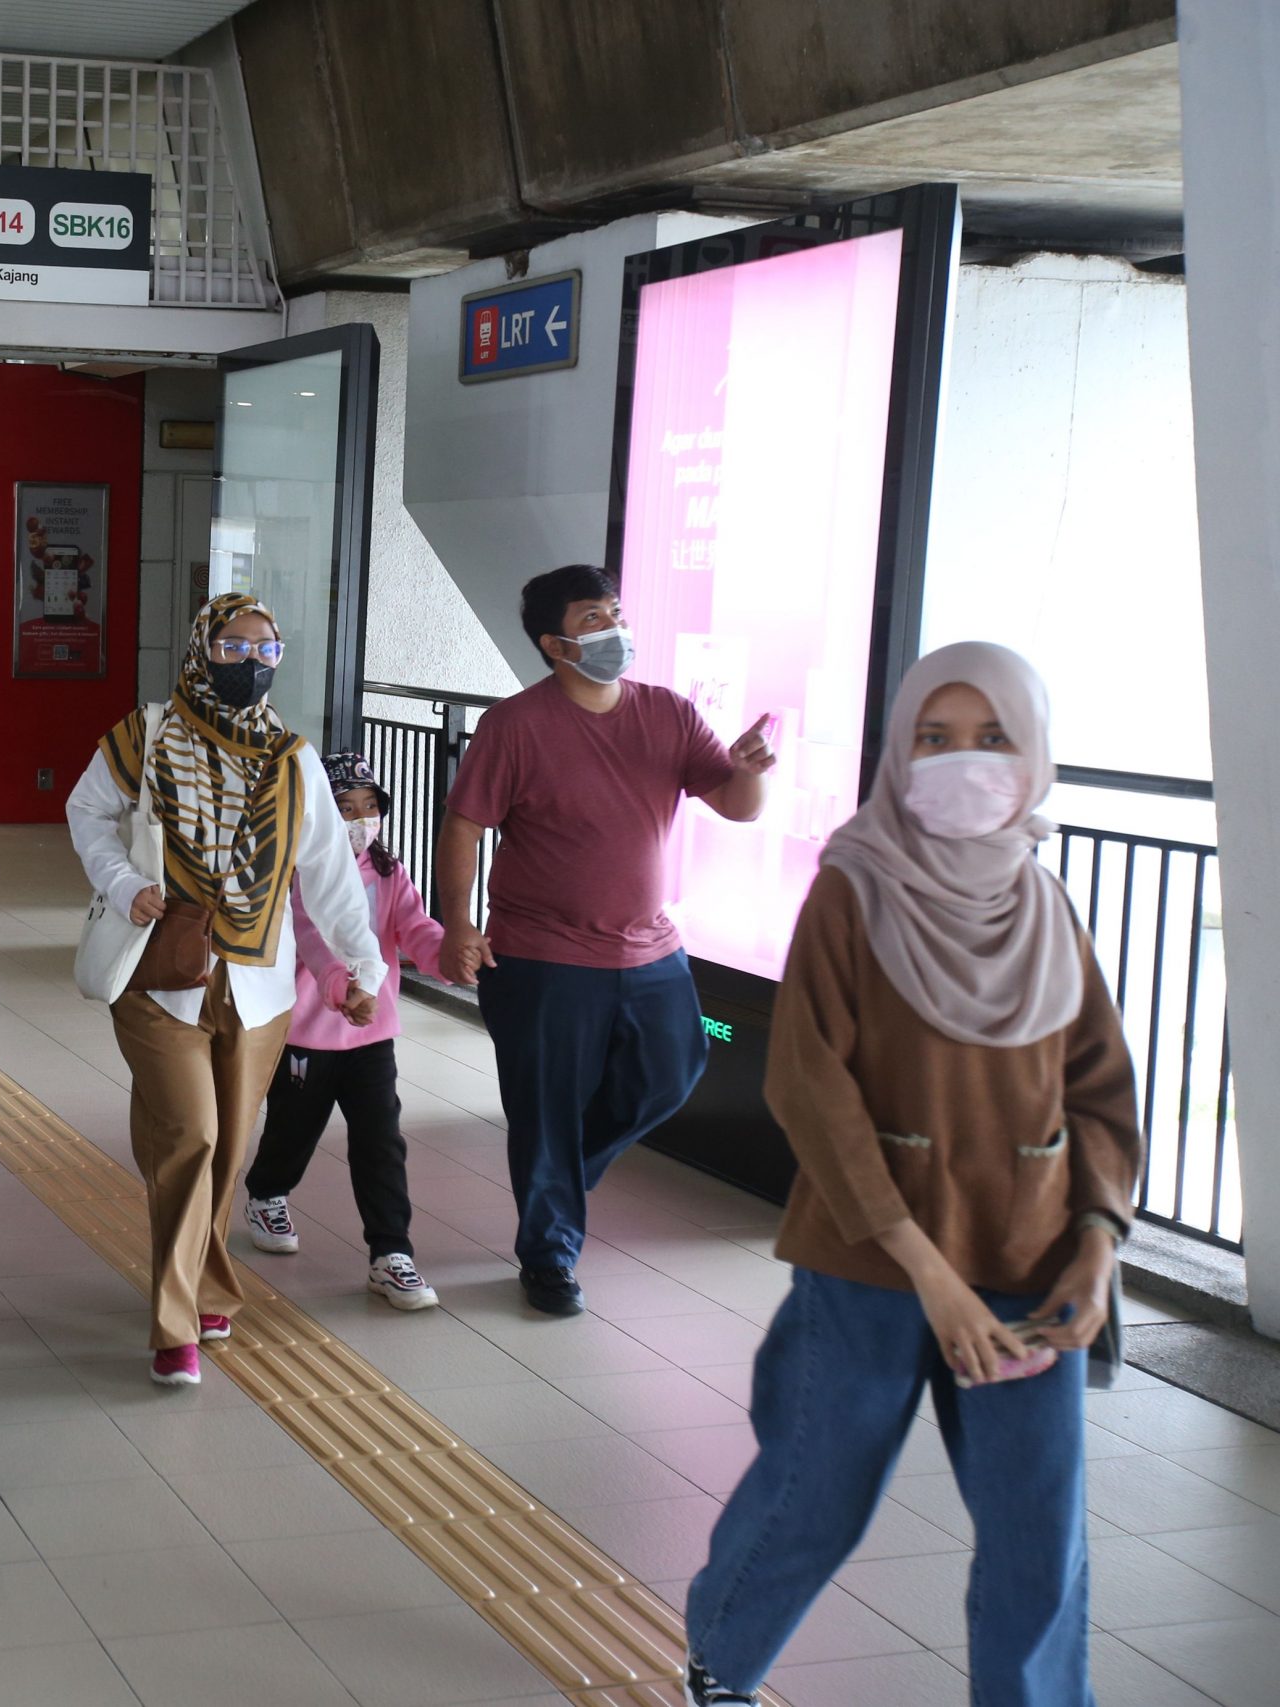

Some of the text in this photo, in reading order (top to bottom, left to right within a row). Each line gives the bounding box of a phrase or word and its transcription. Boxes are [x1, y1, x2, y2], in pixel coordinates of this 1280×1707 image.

[53, 213, 130, 239] SBK16
[501, 310, 535, 349] LRT
[480, 351, 489, 359] LRT
[53, 498, 72, 506] FREE
[45, 517, 80, 526] INSTANT
